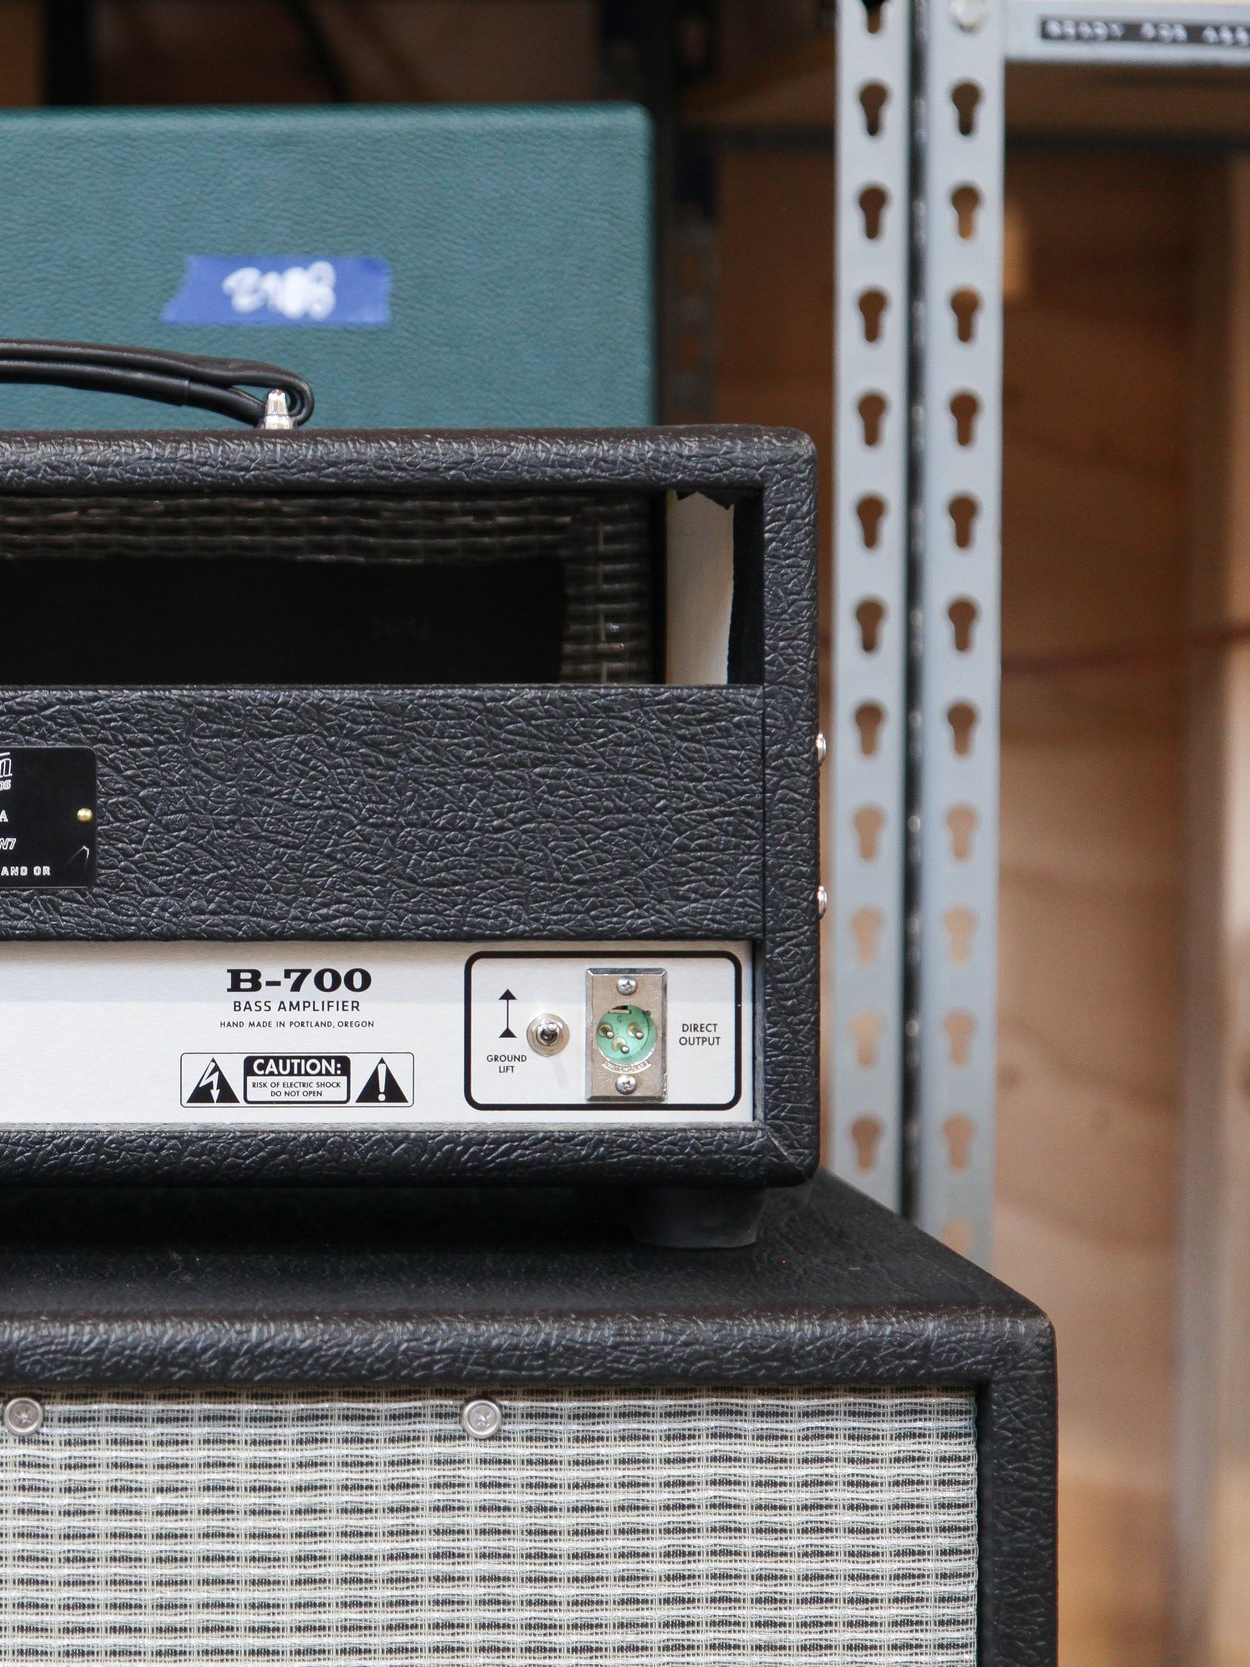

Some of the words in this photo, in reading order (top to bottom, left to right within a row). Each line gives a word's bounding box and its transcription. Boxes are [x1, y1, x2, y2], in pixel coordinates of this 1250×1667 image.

[33, 865, 51, 877] OR
[226, 967, 372, 993] B-700
[233, 1000, 272, 1012] BASS
[277, 1000, 360, 1012] AMPLIFIER
[219, 1020, 245, 1028] HAND
[248, 1020, 272, 1028] MADE
[276, 1020, 286, 1028] IN
[289, 1020, 335, 1029] PORTLAND,
[337, 1020, 375, 1028] OREGON
[681, 1022, 718, 1033] DIRECT
[678, 1036, 721, 1046] OUTPUT
[486, 1054, 528, 1063] GROUND
[252, 1058, 342, 1075] CAUTION:
[498, 1065, 515, 1074] LIFT
[252, 1081, 268, 1089] RISK
[269, 1081, 280, 1089] OF
[282, 1081, 314, 1089] ELECTRIC
[315, 1081, 341, 1089] SHOCK
[270, 1090, 282, 1098] DO
